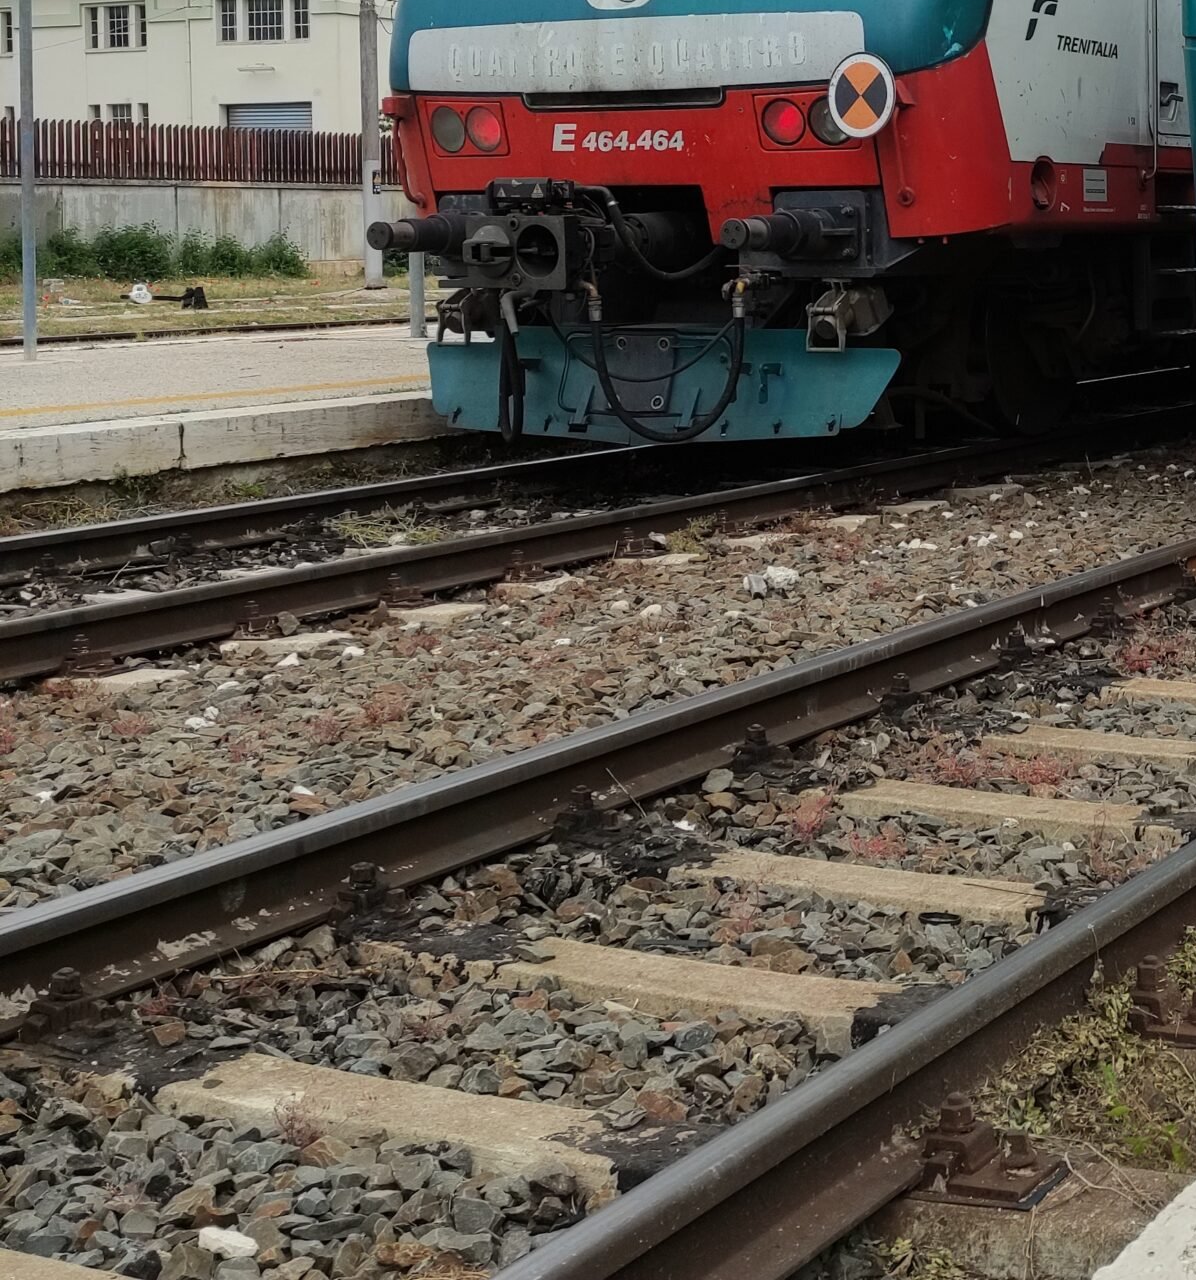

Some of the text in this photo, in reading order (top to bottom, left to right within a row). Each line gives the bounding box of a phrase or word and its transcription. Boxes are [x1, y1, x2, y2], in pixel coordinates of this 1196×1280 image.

[447, 42, 583, 82] QUATTRO
[649, 31, 807, 80] QUATTRO
[1057, 34, 1118, 59] TRENITALIA
[552, 123, 685, 152] E 464.464
